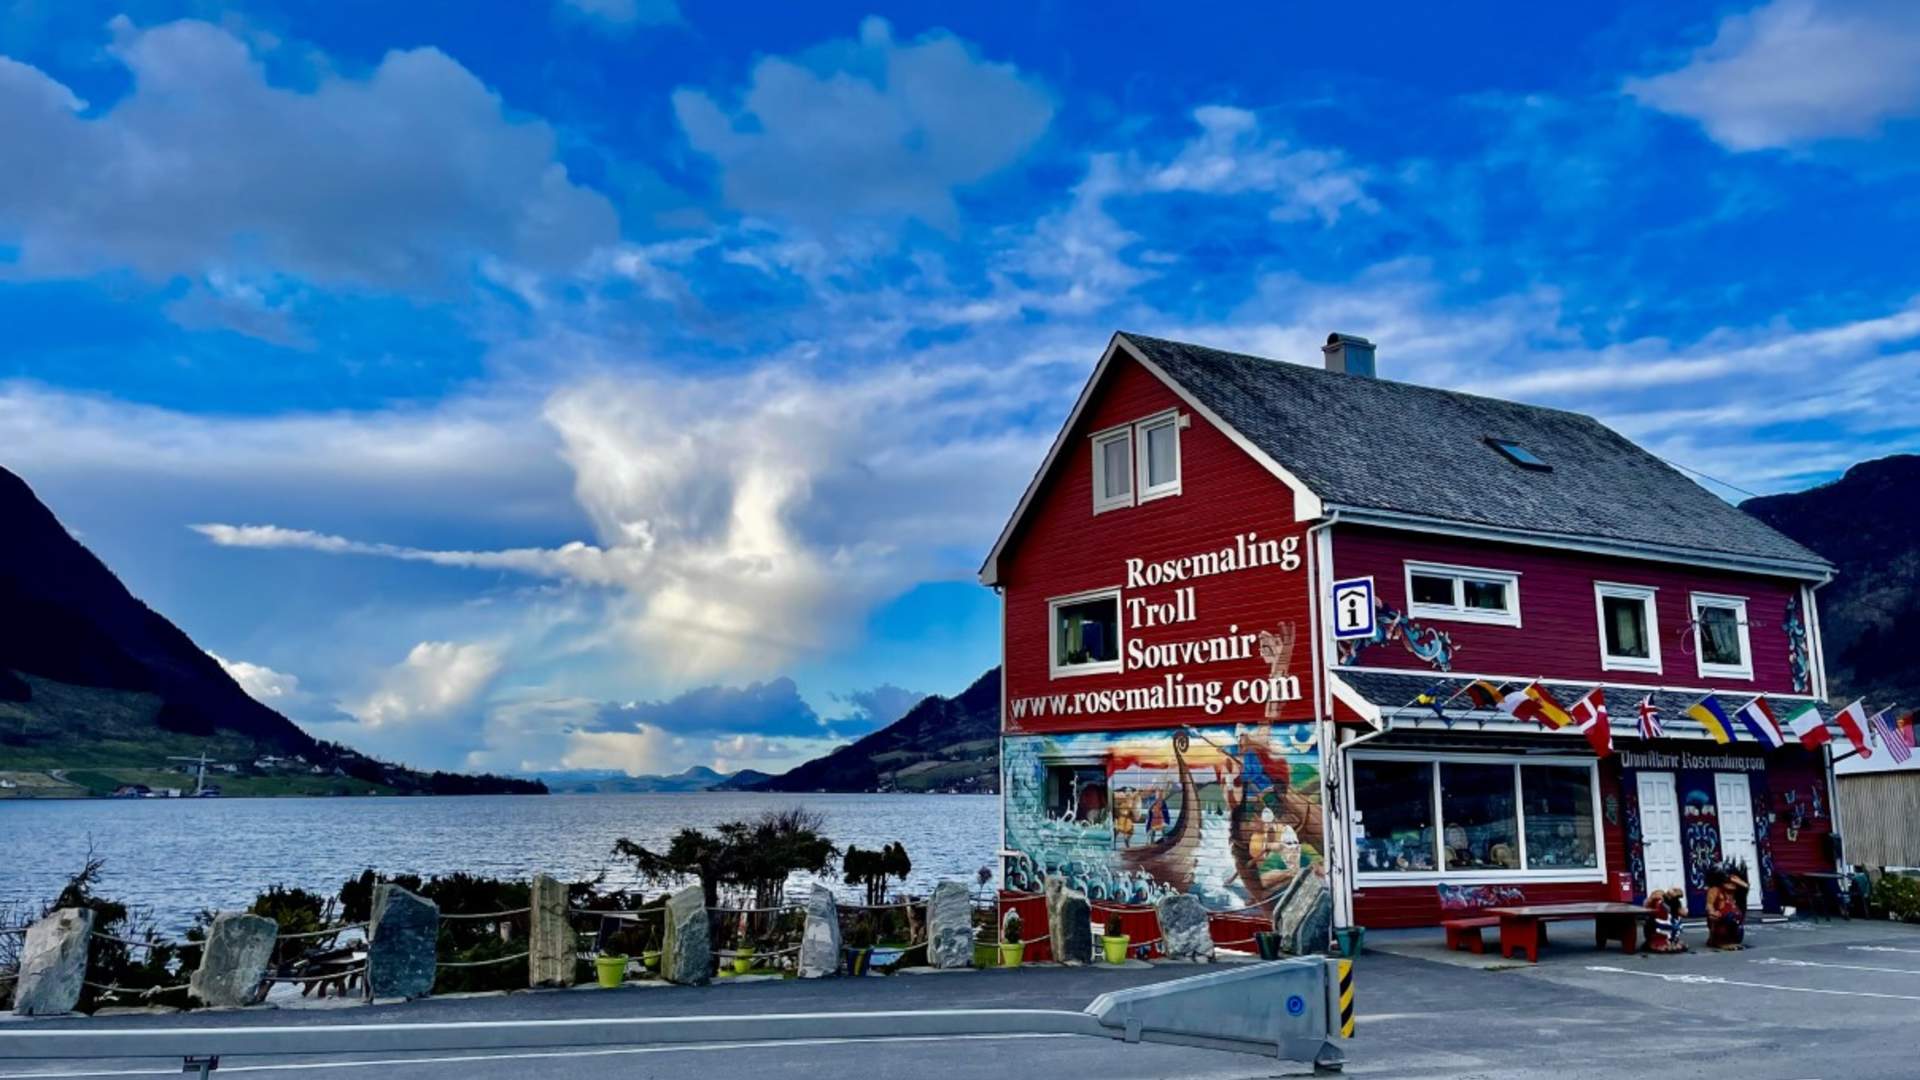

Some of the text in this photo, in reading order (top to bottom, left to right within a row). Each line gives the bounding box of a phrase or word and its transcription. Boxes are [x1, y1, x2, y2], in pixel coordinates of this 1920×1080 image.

[1126, 532, 1300, 589] Rosemaling
[1127, 587, 1196, 629] Troll
[1127, 625, 1257, 671] Souvenir
[1011, 673, 1302, 718] www.rosemaling.com
